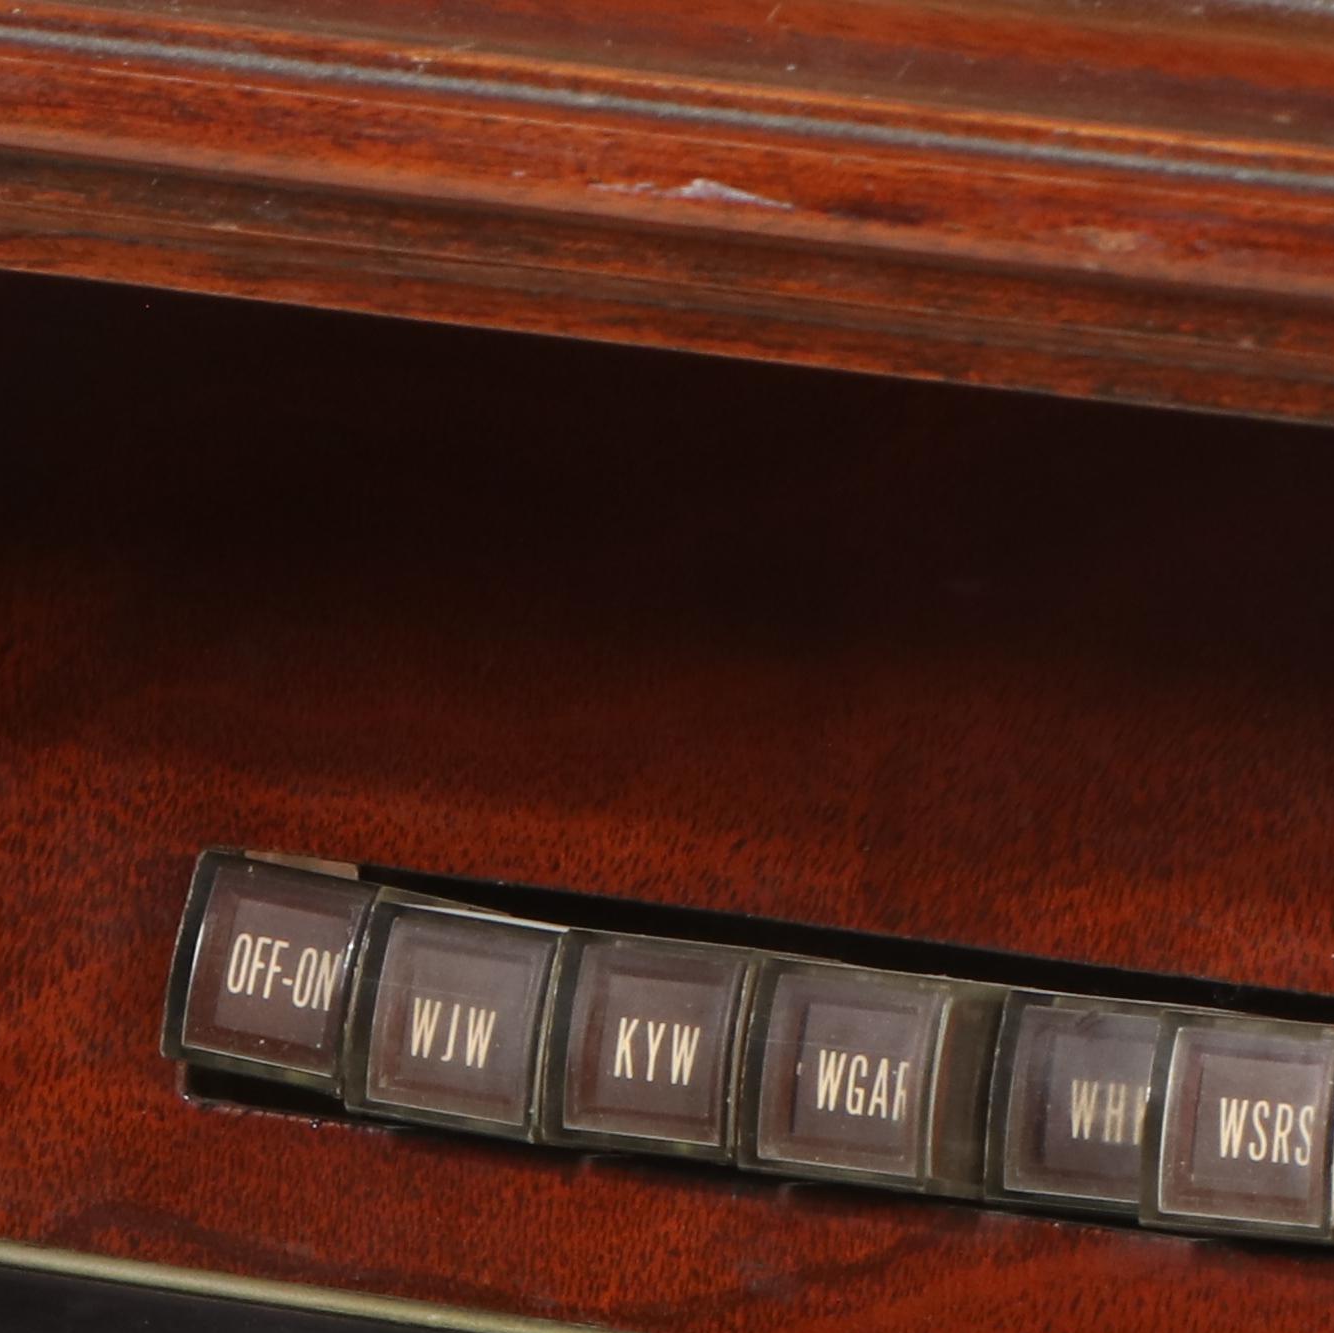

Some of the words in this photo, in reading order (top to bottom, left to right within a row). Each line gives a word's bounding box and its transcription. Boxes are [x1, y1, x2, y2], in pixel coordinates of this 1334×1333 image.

[227, 933, 343, 1011] OFF-ON
[411, 997, 496, 1069] WJW
[614, 1017, 700, 1086] KYW
[1220, 1097, 1316, 1166] WSRS
